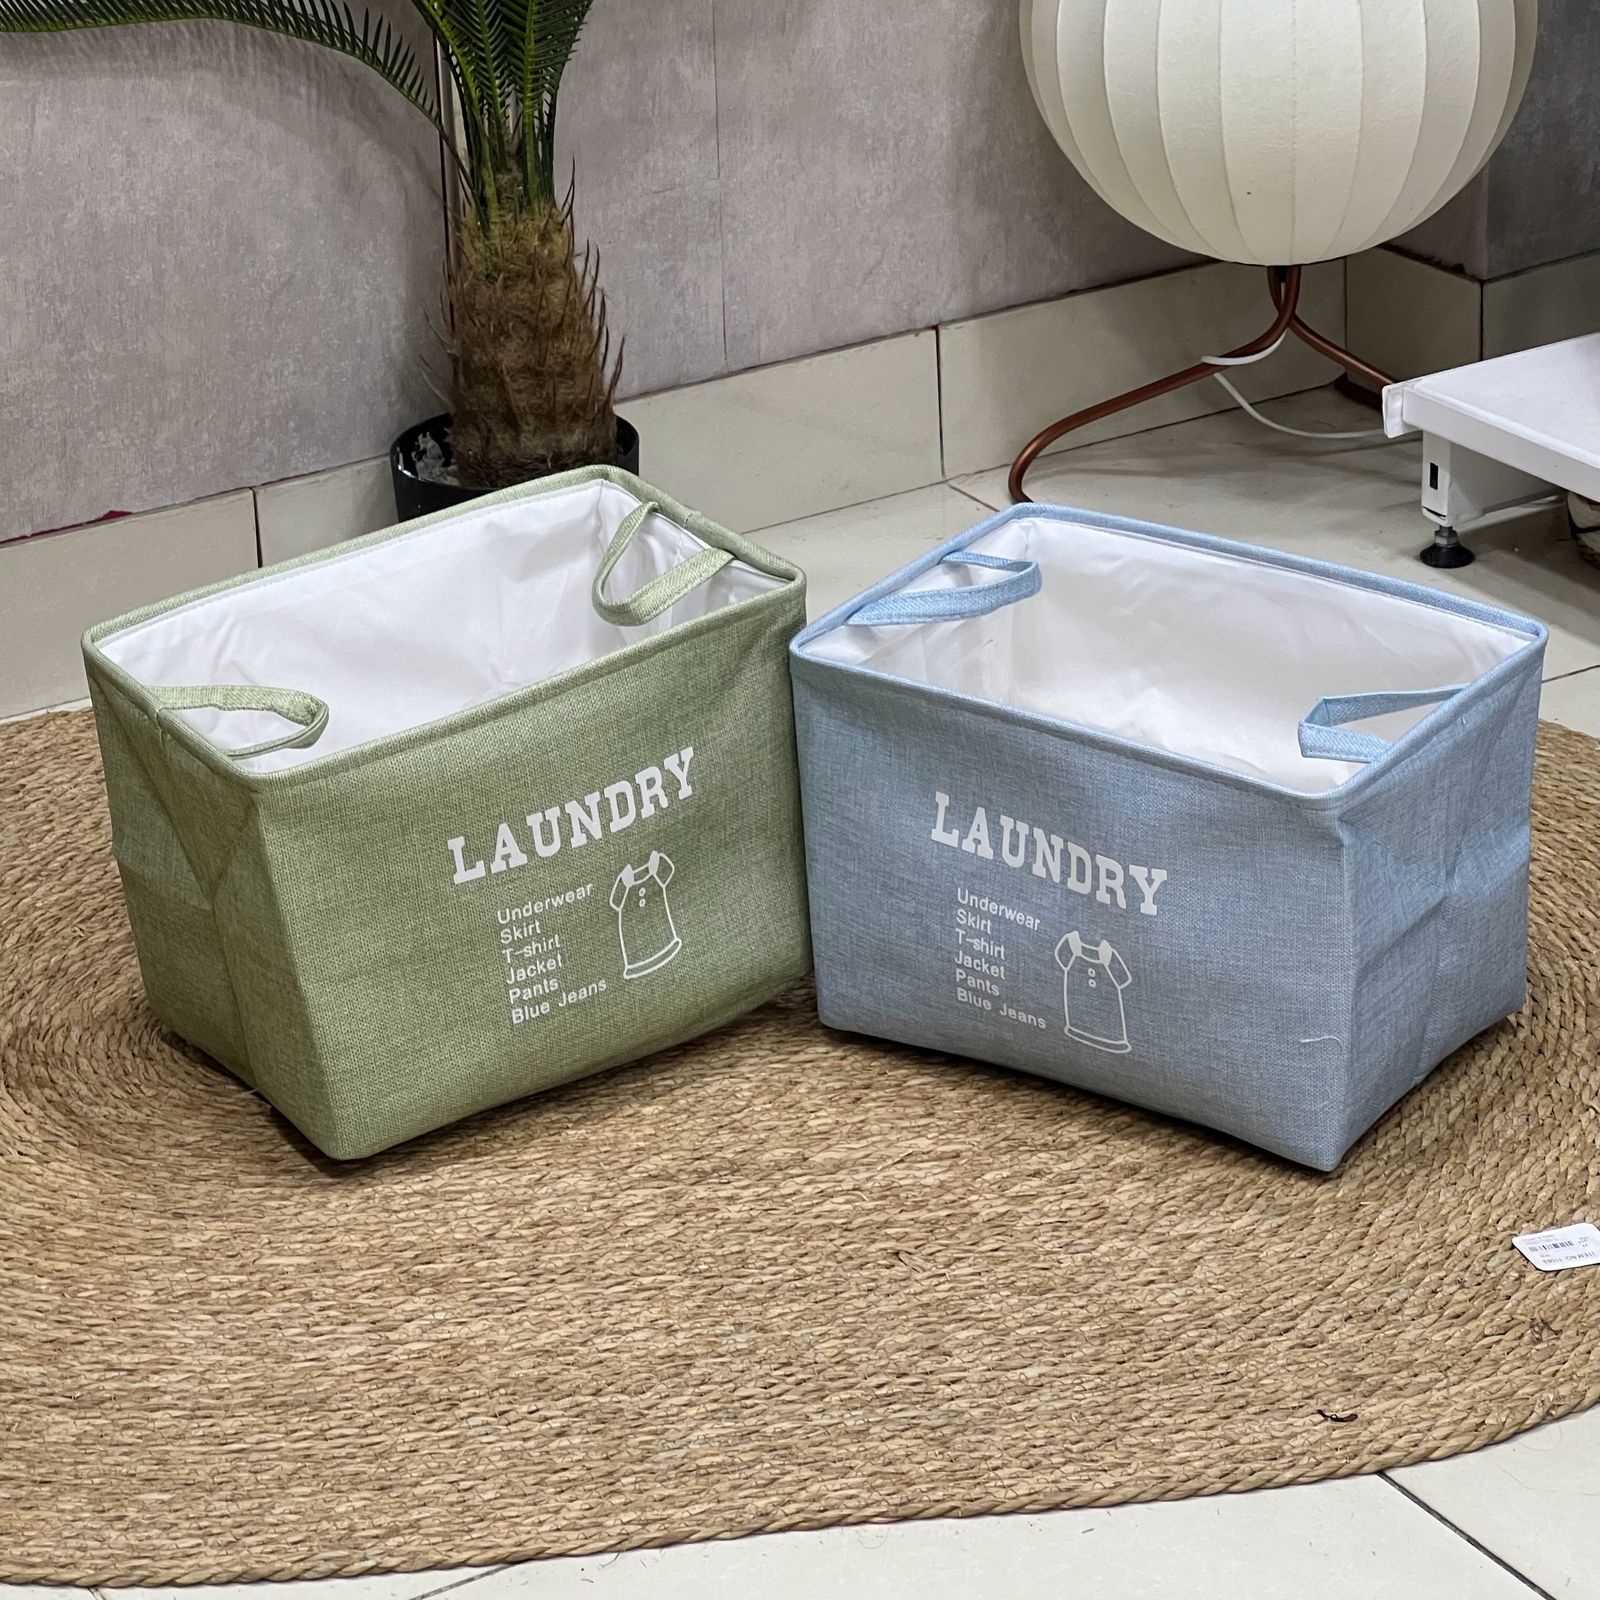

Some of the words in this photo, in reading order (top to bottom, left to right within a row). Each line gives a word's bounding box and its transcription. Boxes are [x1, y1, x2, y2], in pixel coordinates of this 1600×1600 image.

[448, 747, 694, 885] LAUNDRY
[931, 791, 1167, 916] LAUNDRY
[497, 883, 593, 925] Underwear
[957, 888, 1040, 931] Underwear
[500, 920, 542, 945] Skirt
[956, 908, 992, 934] Skirt
[502, 934, 561, 963] T-shirt
[955, 928, 1005, 961] T-shirt
[506, 954, 563, 985] Jacket
[954, 950, 1005, 980] Jacket
[509, 979, 558, 1004] Pants
[956, 969, 1000, 996] Pants
[511, 1002, 550, 1025] Blue
[558, 980, 607, 1007] Jeans
[957, 987, 992, 1011] Blue
[999, 1002, 1046, 1029] Jeans
